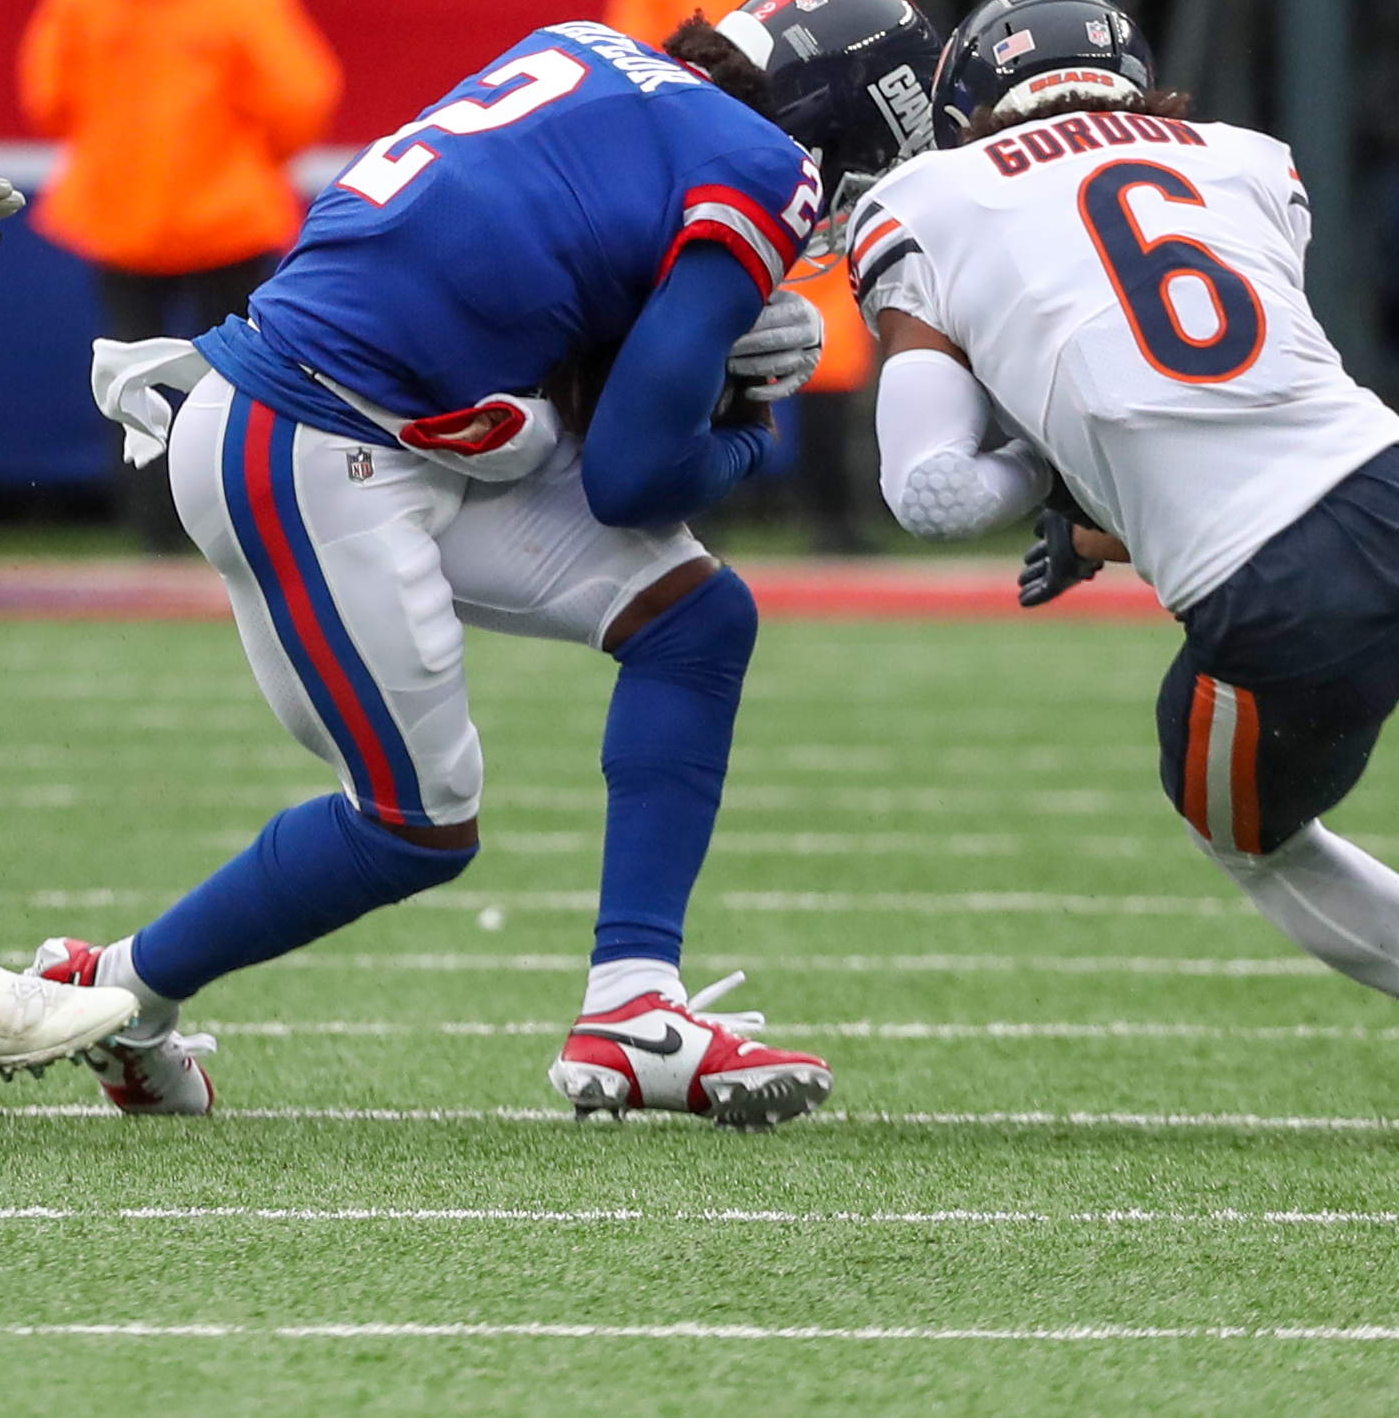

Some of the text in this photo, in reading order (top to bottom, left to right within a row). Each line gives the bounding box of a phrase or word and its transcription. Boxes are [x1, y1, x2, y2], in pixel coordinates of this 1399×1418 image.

[753, 2, 776, 20] 2
[1029, 71, 1115, 94] BEARS
[336, 46, 591, 209] 2
[983, 111, 1208, 178] GORDON
[778, 156, 824, 239] 2
[1077, 158, 1267, 384] 6
